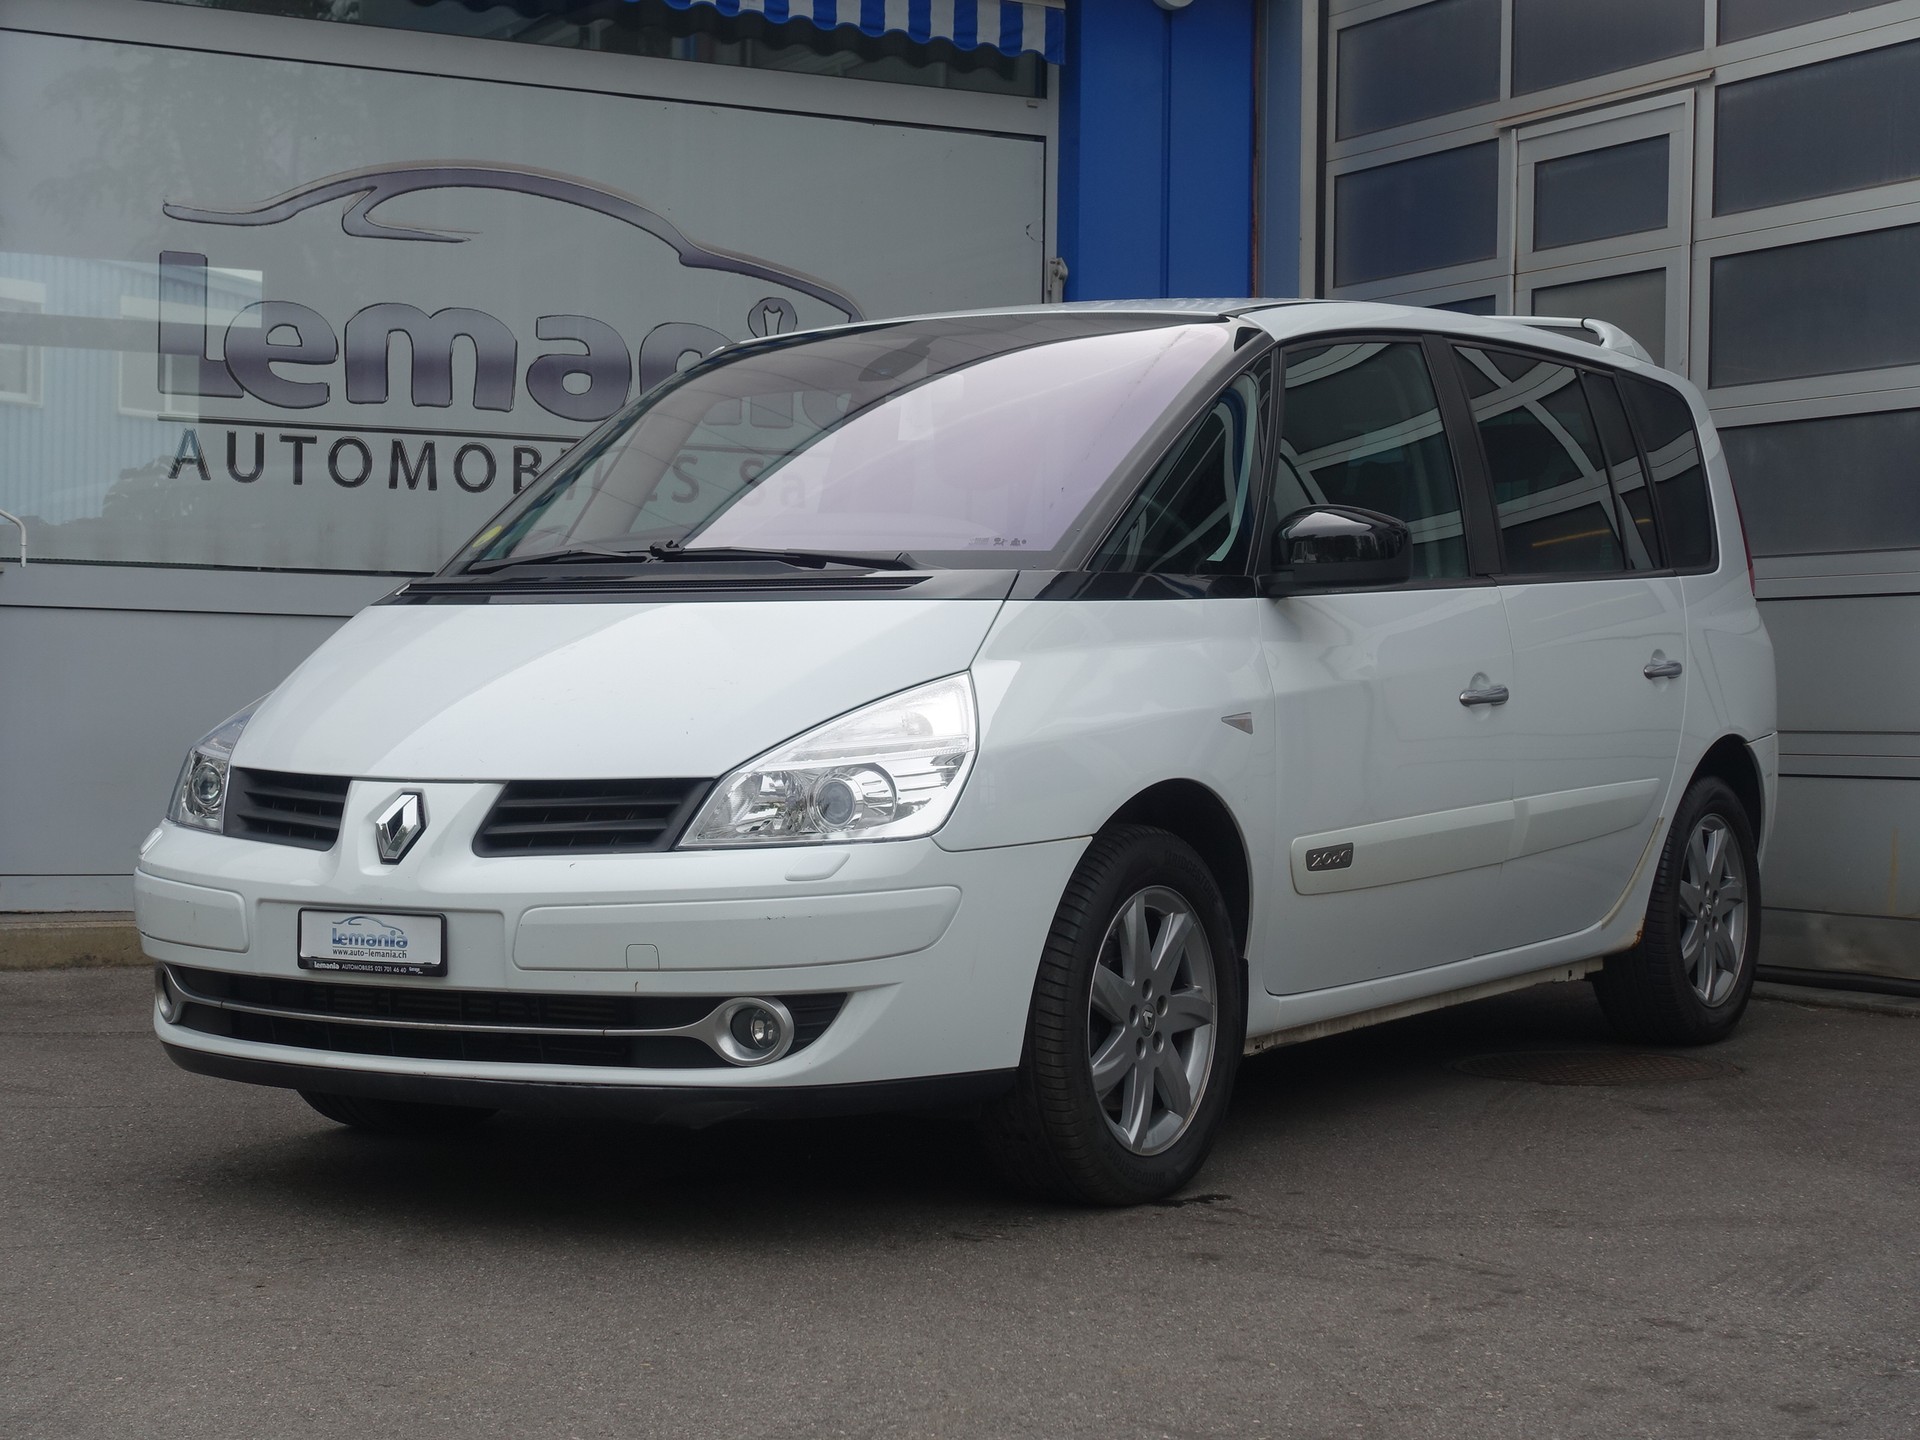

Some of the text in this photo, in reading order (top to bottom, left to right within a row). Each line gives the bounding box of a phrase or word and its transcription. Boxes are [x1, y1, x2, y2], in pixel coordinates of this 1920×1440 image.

[168, 428, 700, 504] AUTOMOBS
[332, 928, 408, 948] Lemania
[333, 948, 407, 959] www.auto-lemania.ch
